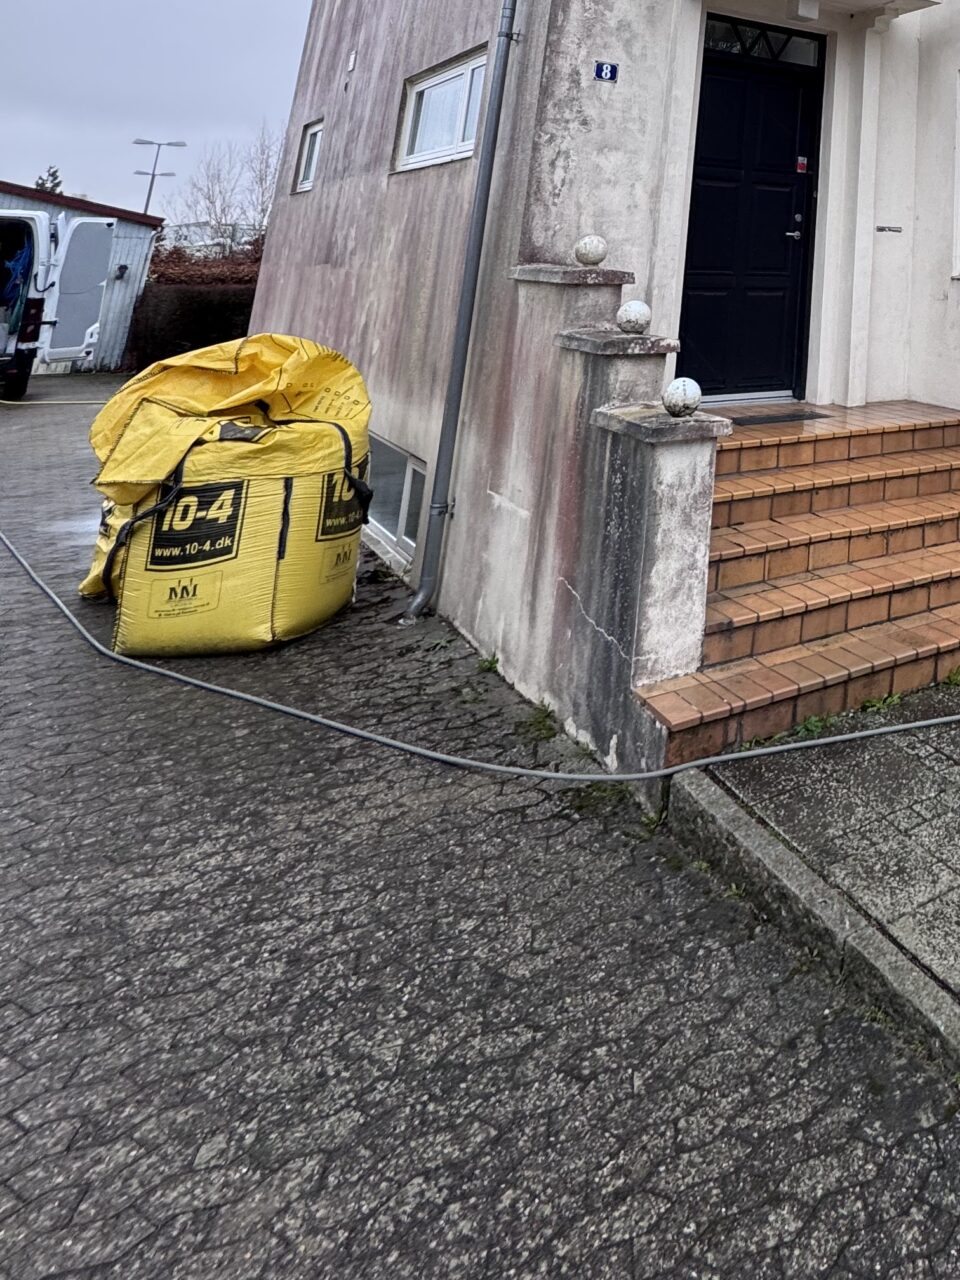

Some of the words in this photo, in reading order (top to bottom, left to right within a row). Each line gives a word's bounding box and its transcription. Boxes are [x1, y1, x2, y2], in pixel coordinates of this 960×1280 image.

[601, 64, 611, 79] 8
[162, 489, 235, 531] 10-4
[155, 536, 233, 556] www.10-4.dk
